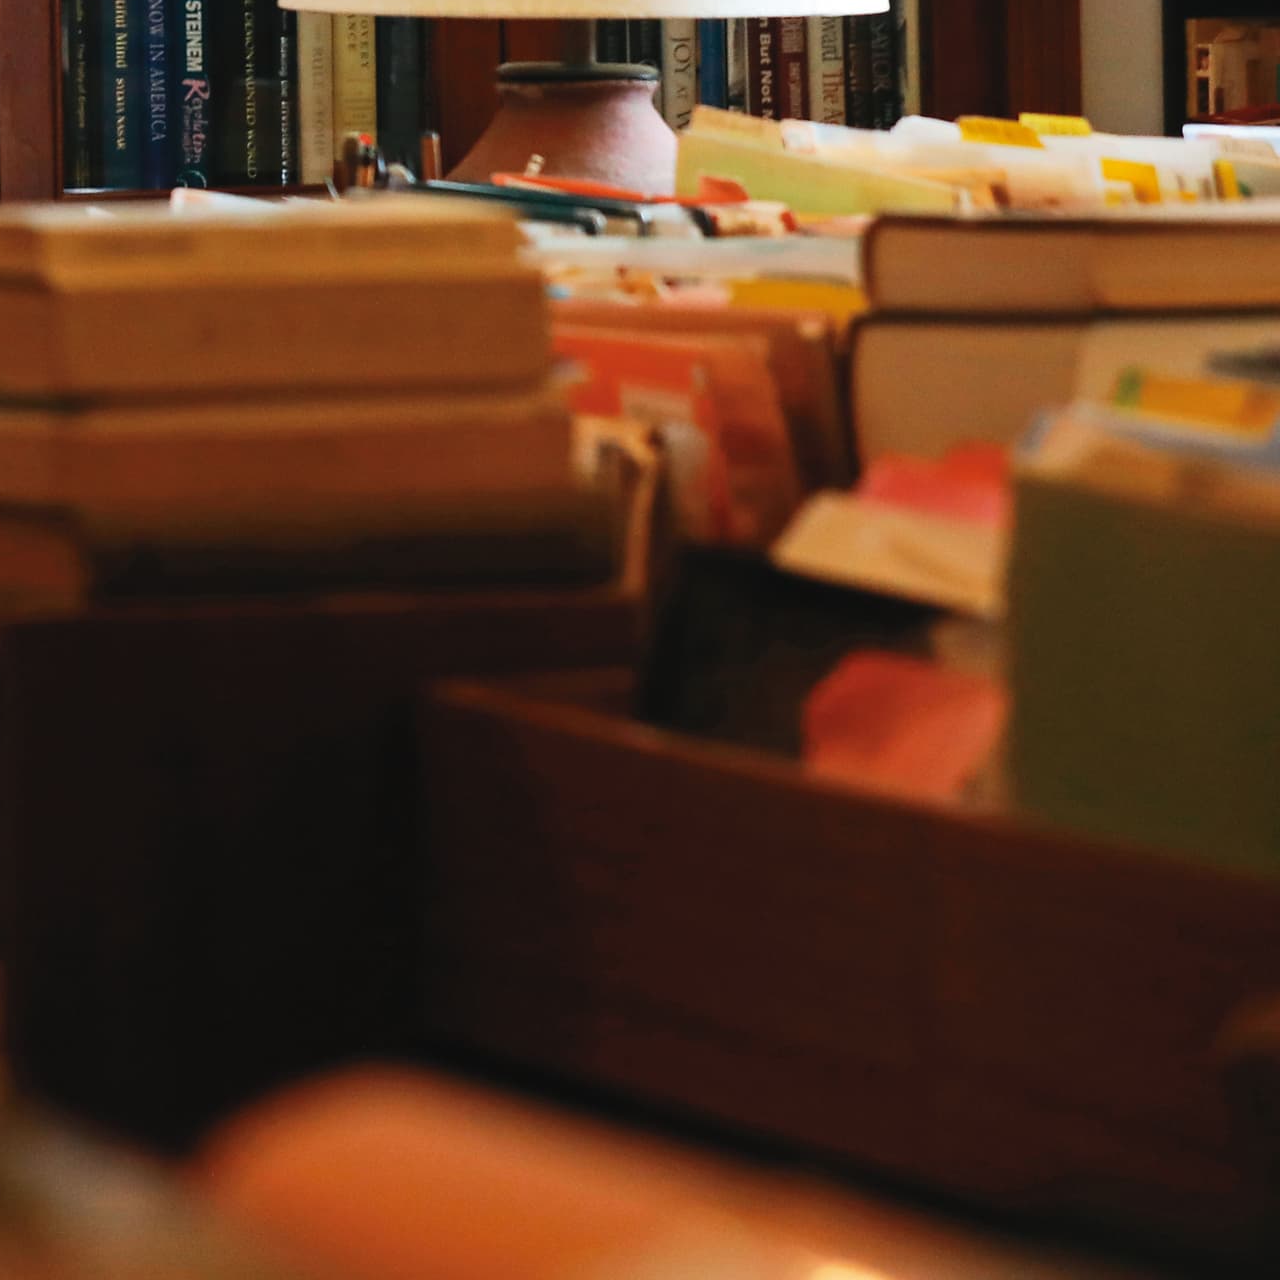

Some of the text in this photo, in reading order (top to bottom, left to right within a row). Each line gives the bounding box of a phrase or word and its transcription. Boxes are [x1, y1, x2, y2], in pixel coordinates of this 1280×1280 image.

[115, 31, 128, 68] Mind
[149, 42, 164, 59] IN
[184, 0, 202, 73] STEINEM
[671, 37, 691, 73] JOY
[759, 34, 773, 106] But Not
[150, 66, 167, 142] AMERICA
